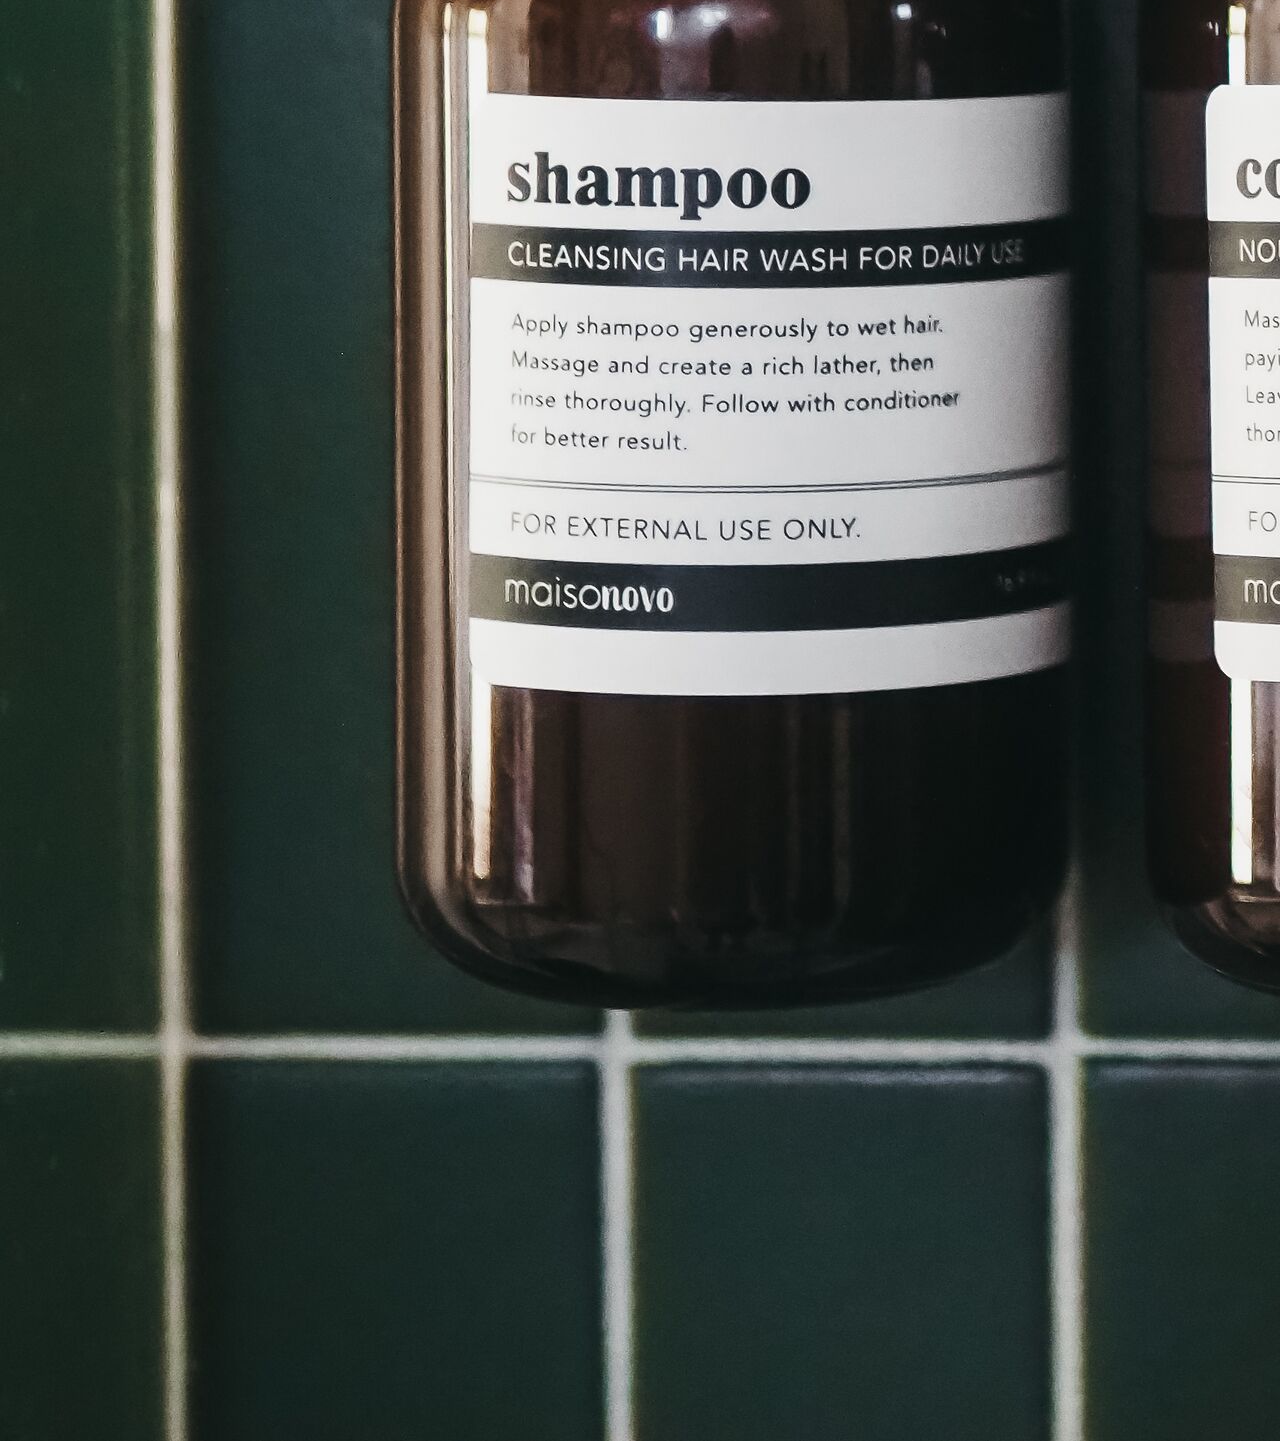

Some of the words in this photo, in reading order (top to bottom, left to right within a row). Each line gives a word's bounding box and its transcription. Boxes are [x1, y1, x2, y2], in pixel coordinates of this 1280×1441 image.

[507, 152, 811, 221] shampoo
[508, 241, 666, 272] CLEANSING
[679, 247, 748, 272] HAIR
[760, 247, 847, 272] WASH
[859, 245, 913, 270] FOR
[923, 243, 984, 268] DAILY
[511, 313, 568, 339] Apply
[576, 315, 679, 341] shampoo
[689, 318, 818, 343] generously
[827, 321, 849, 337] to
[858, 319, 896, 335] wet
[904, 314, 943, 335] hair.
[511, 350, 599, 377] Massage
[608, 353, 649, 375] and
[659, 359, 731, 376] create
[741, 362, 752, 375] a
[762, 354, 804, 376] rich
[812, 353, 881, 377] lather,
[890, 352, 934, 373] then
[511, 389, 556, 410] rinse
[564, 391, 692, 418] thoroughly.
[702, 393, 779, 414] Follow
[788, 393, 836, 413] with
[844, 389, 960, 412] conditioner
[511, 424, 536, 445] for
[544, 427, 609, 449] better
[617, 430, 688, 451] result.
[510, 512, 557, 535] FOR
[567, 516, 707, 541] EXTERNAL
[719, 519, 771, 541] USE
[783, 518, 861, 540] ONLY.
[504, 577, 674, 613] maisonovo
